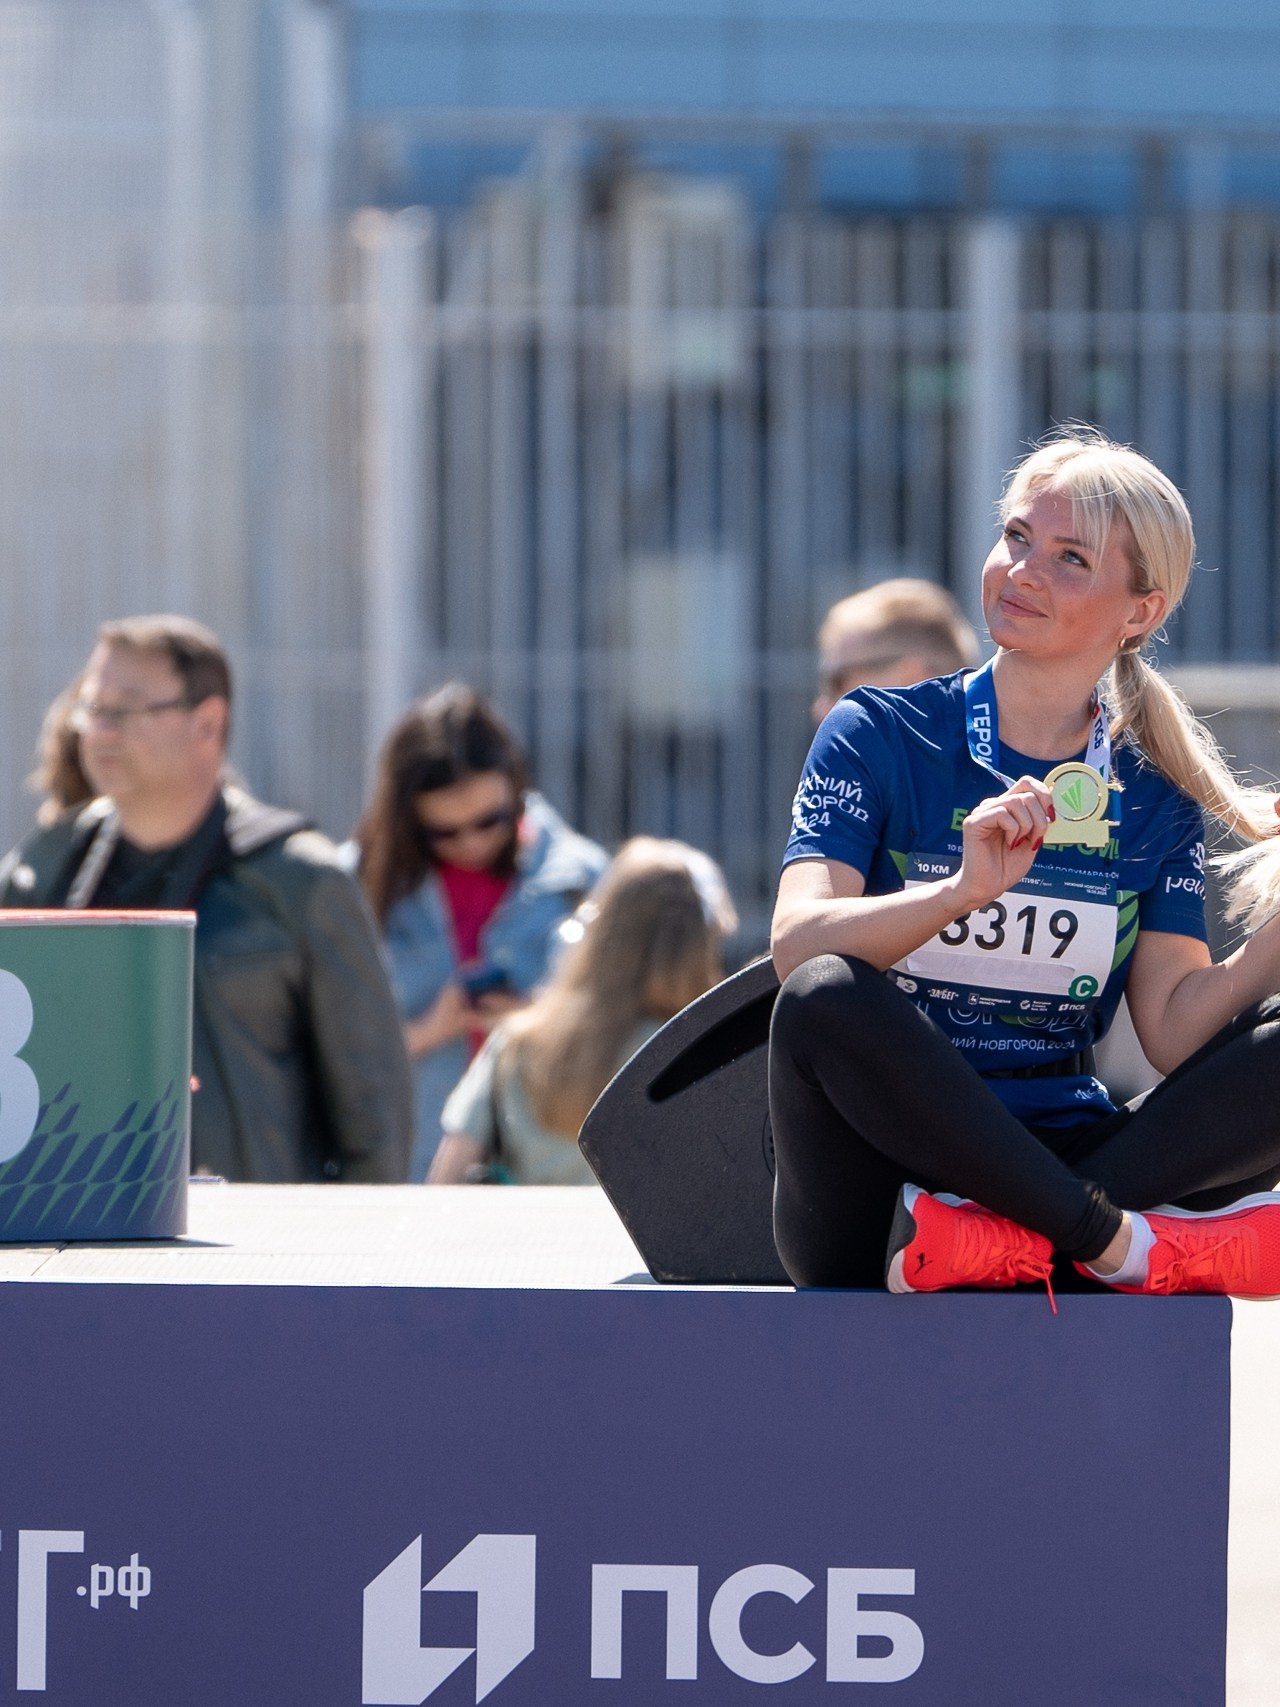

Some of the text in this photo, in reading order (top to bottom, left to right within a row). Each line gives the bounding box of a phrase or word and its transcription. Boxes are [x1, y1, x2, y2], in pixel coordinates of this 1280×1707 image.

[917, 863, 950, 875] 10 КМ
[939, 900, 1079, 959] 3319
[978, 1038, 1046, 1051] НОВГОРОД
[0, 1530, 151, 1690] Г.рф
[591, 1563, 925, 1685] ПСБ
